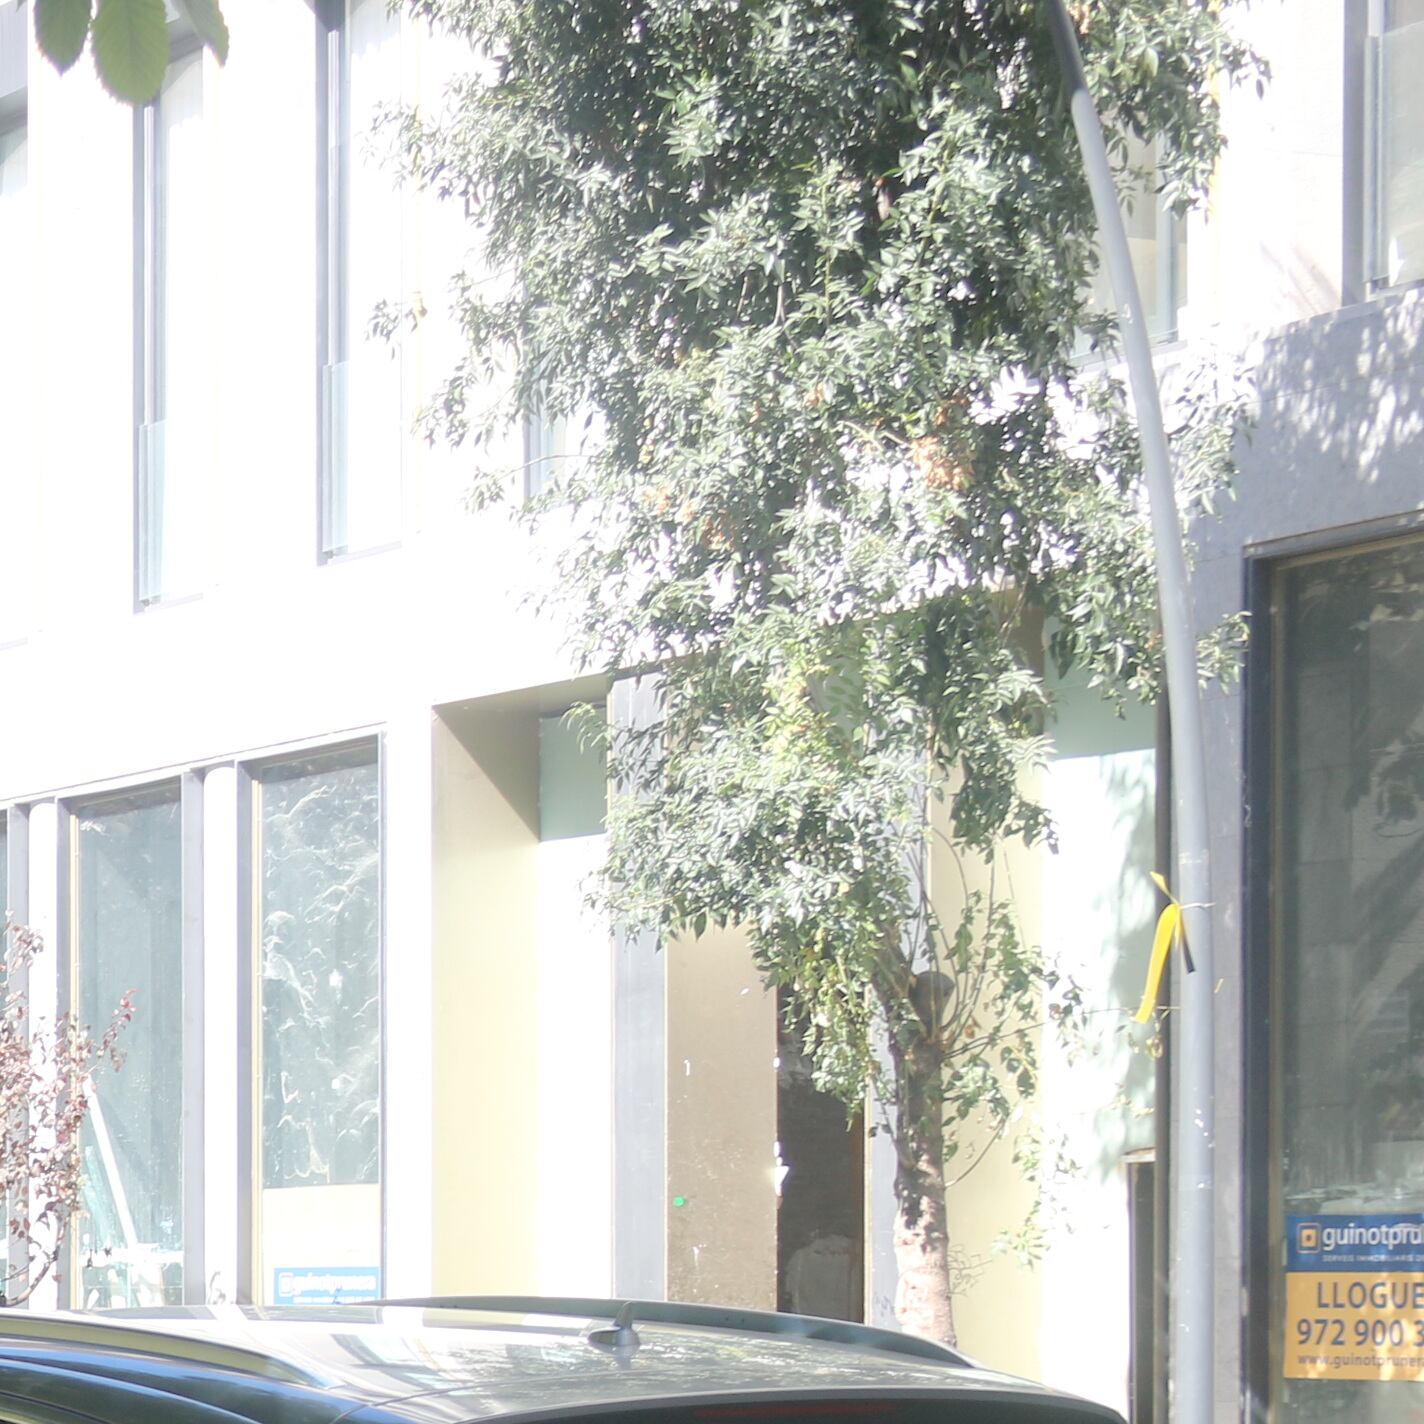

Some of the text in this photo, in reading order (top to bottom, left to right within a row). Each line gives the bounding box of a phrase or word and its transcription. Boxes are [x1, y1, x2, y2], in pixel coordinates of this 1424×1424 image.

[1323, 1223, 1424, 1250] guinotpru
[1297, 1318, 1345, 1345] 972
[1354, 1318, 1404, 1346] 900
